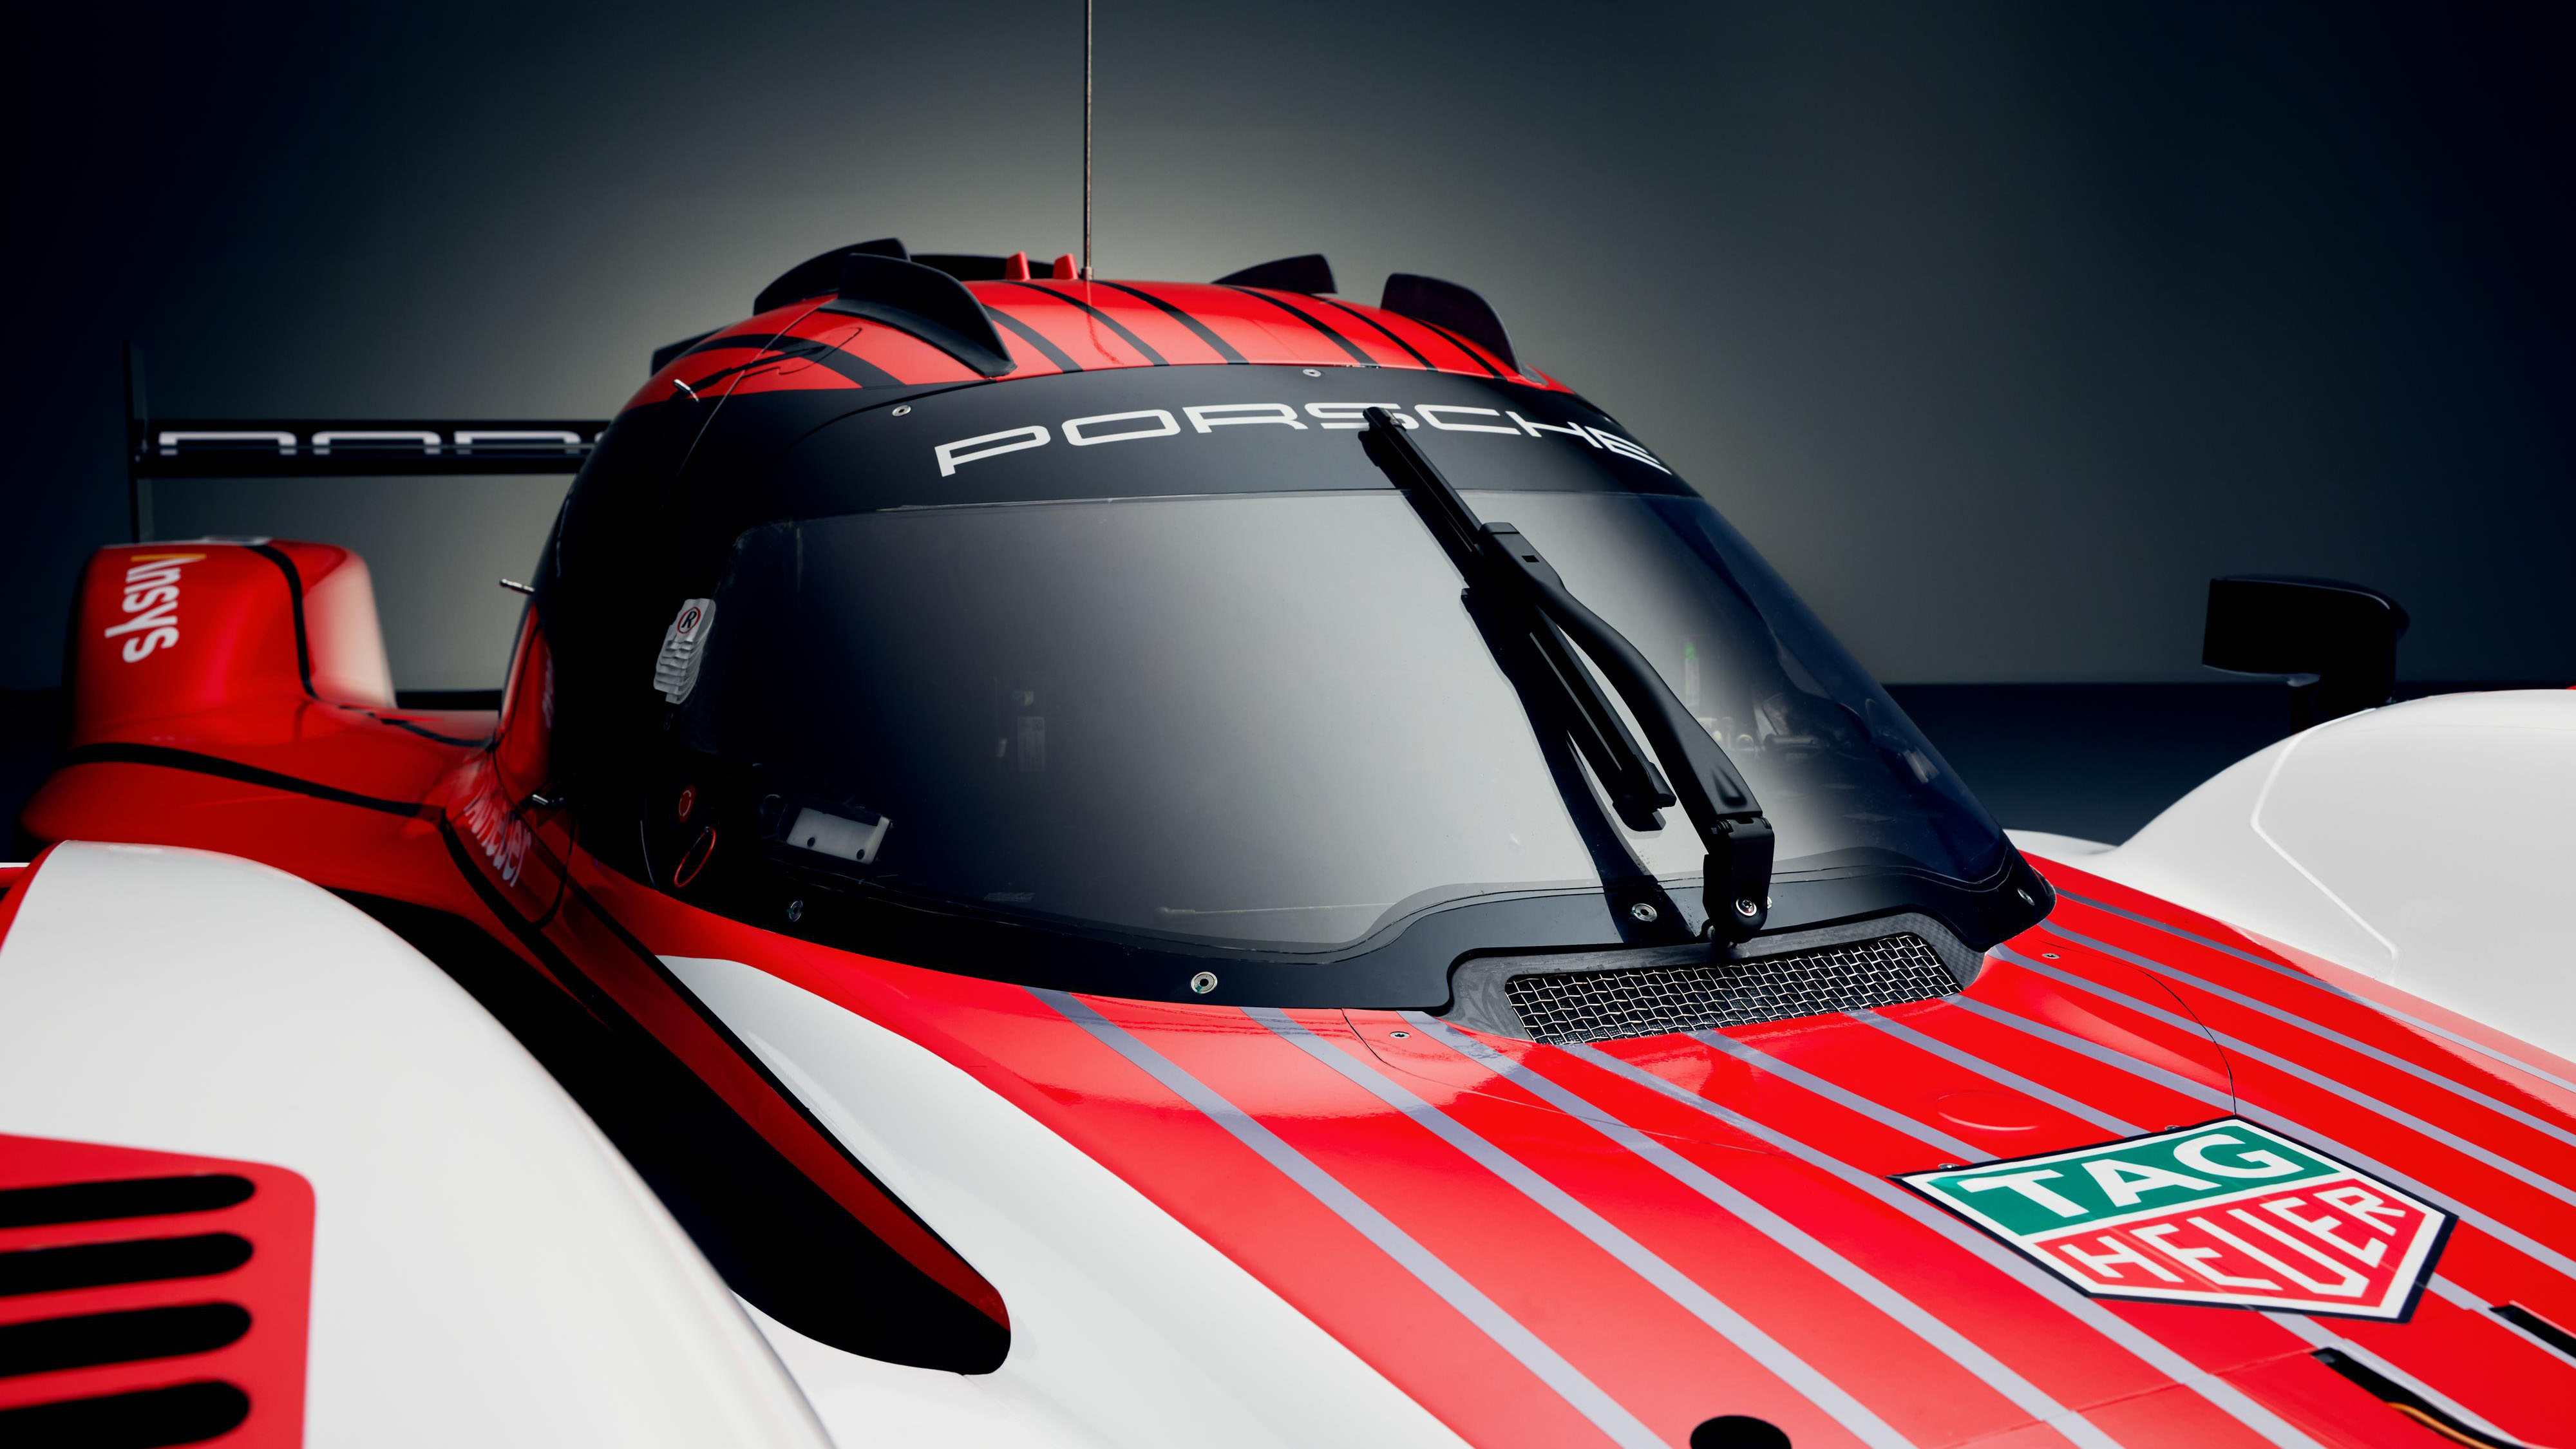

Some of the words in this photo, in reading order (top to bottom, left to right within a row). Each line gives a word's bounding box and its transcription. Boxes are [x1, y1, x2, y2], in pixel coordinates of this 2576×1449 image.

[934, 402, 1672, 477] PORSCHE
[104, 553, 206, 663] Ansys
[1956, 1133, 2305, 1218] TAG
[2058, 1186, 2407, 1298] HEUER
